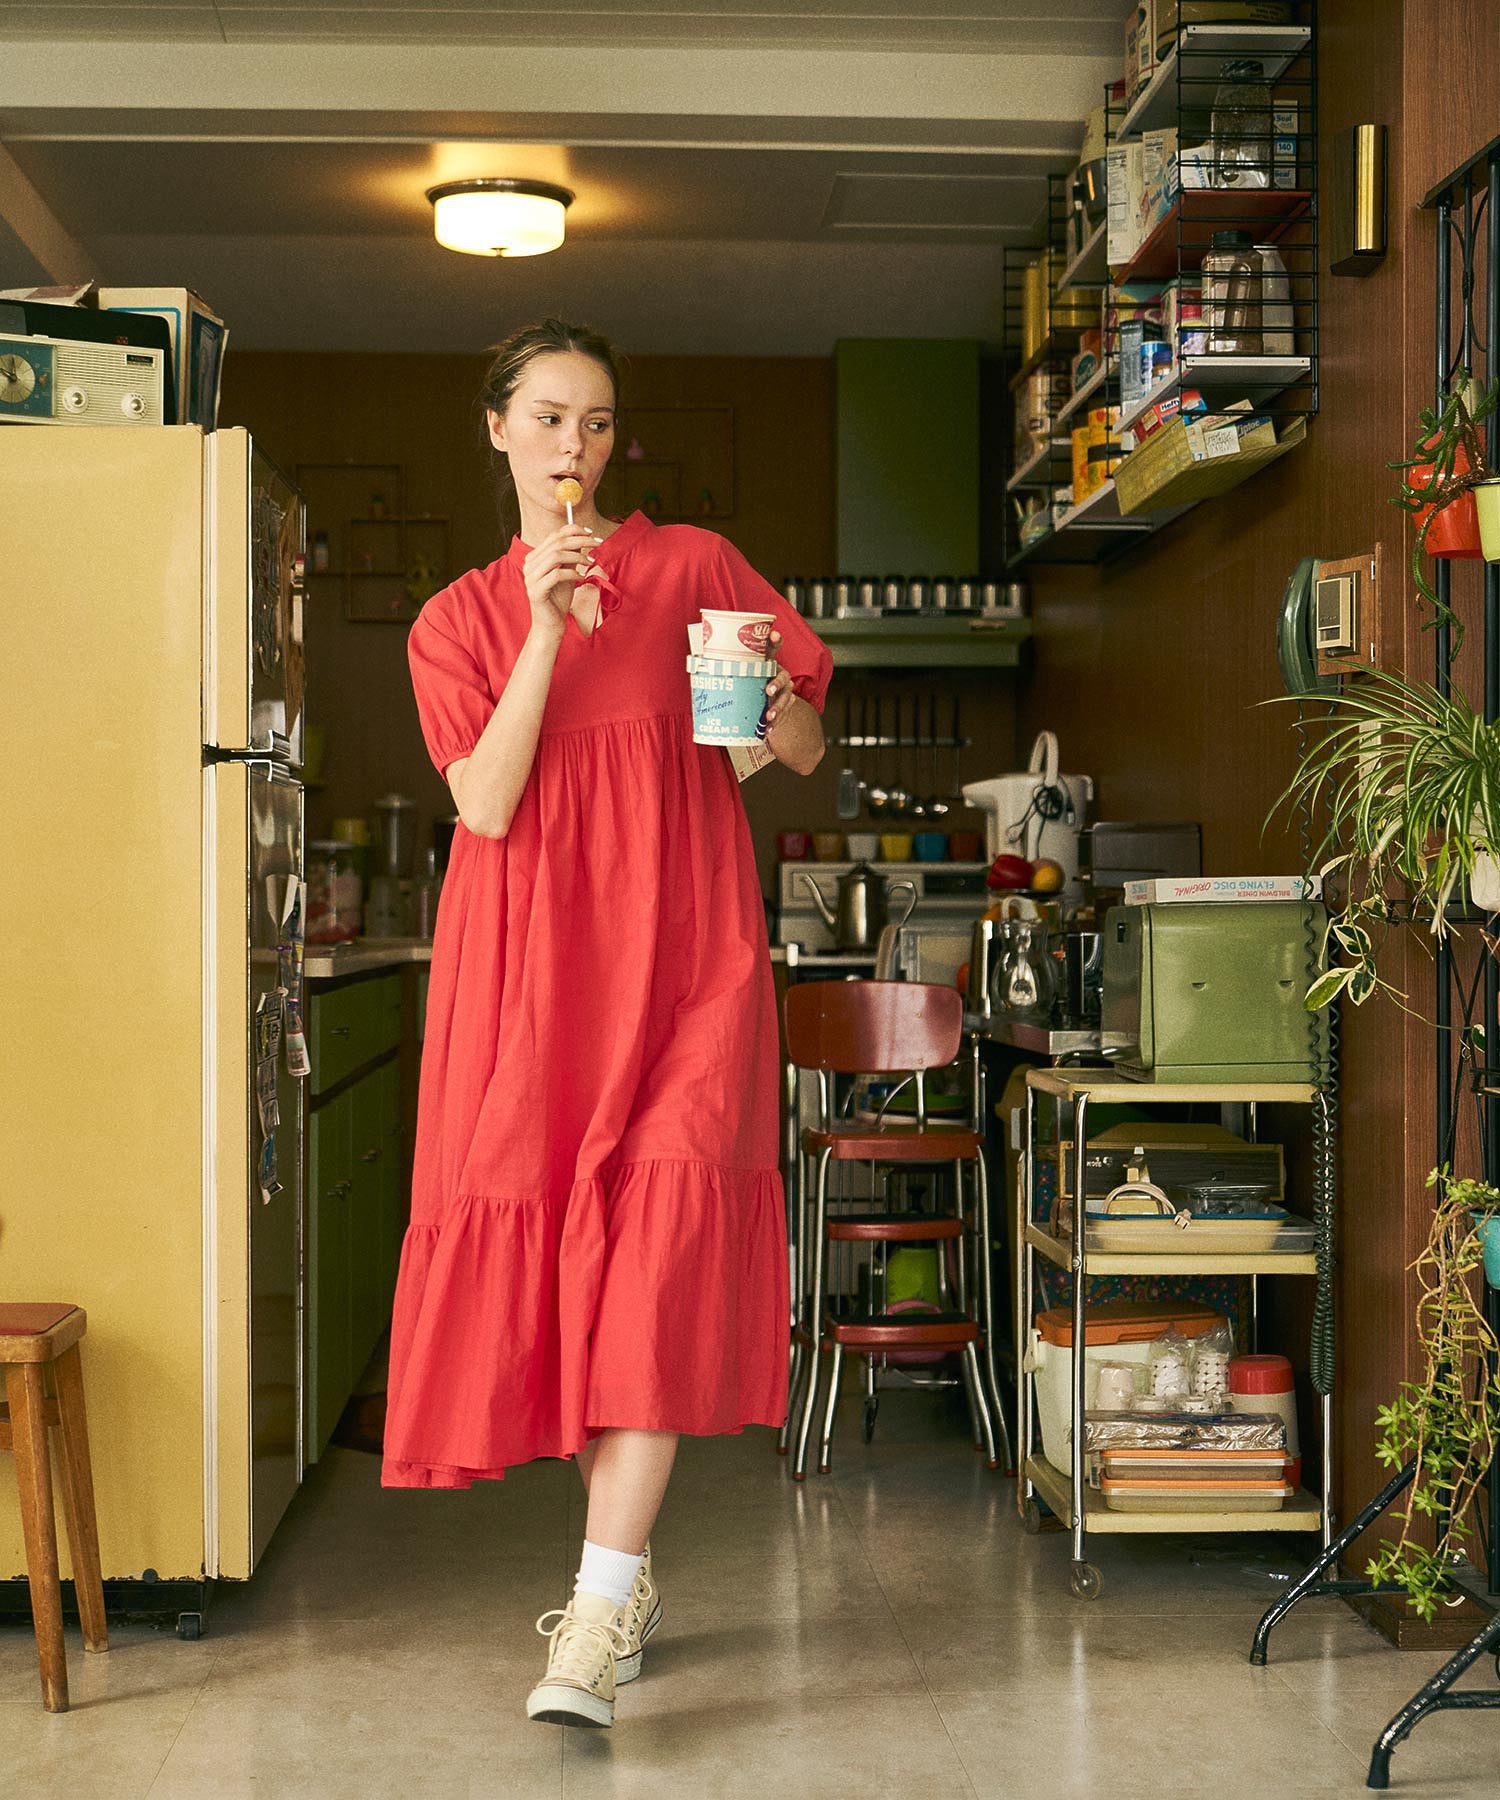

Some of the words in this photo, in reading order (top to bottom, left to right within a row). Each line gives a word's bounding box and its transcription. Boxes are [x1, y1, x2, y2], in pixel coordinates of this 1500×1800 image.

[1161, 399, 1180, 411] Hefty
[707, 718, 722, 726] ICE
[699, 725, 729, 734] CREAM
[1174, 881, 1212, 897] ORIGINAL
[1213, 881, 1237, 890] DISC
[1238, 881, 1275, 890] FLYING
